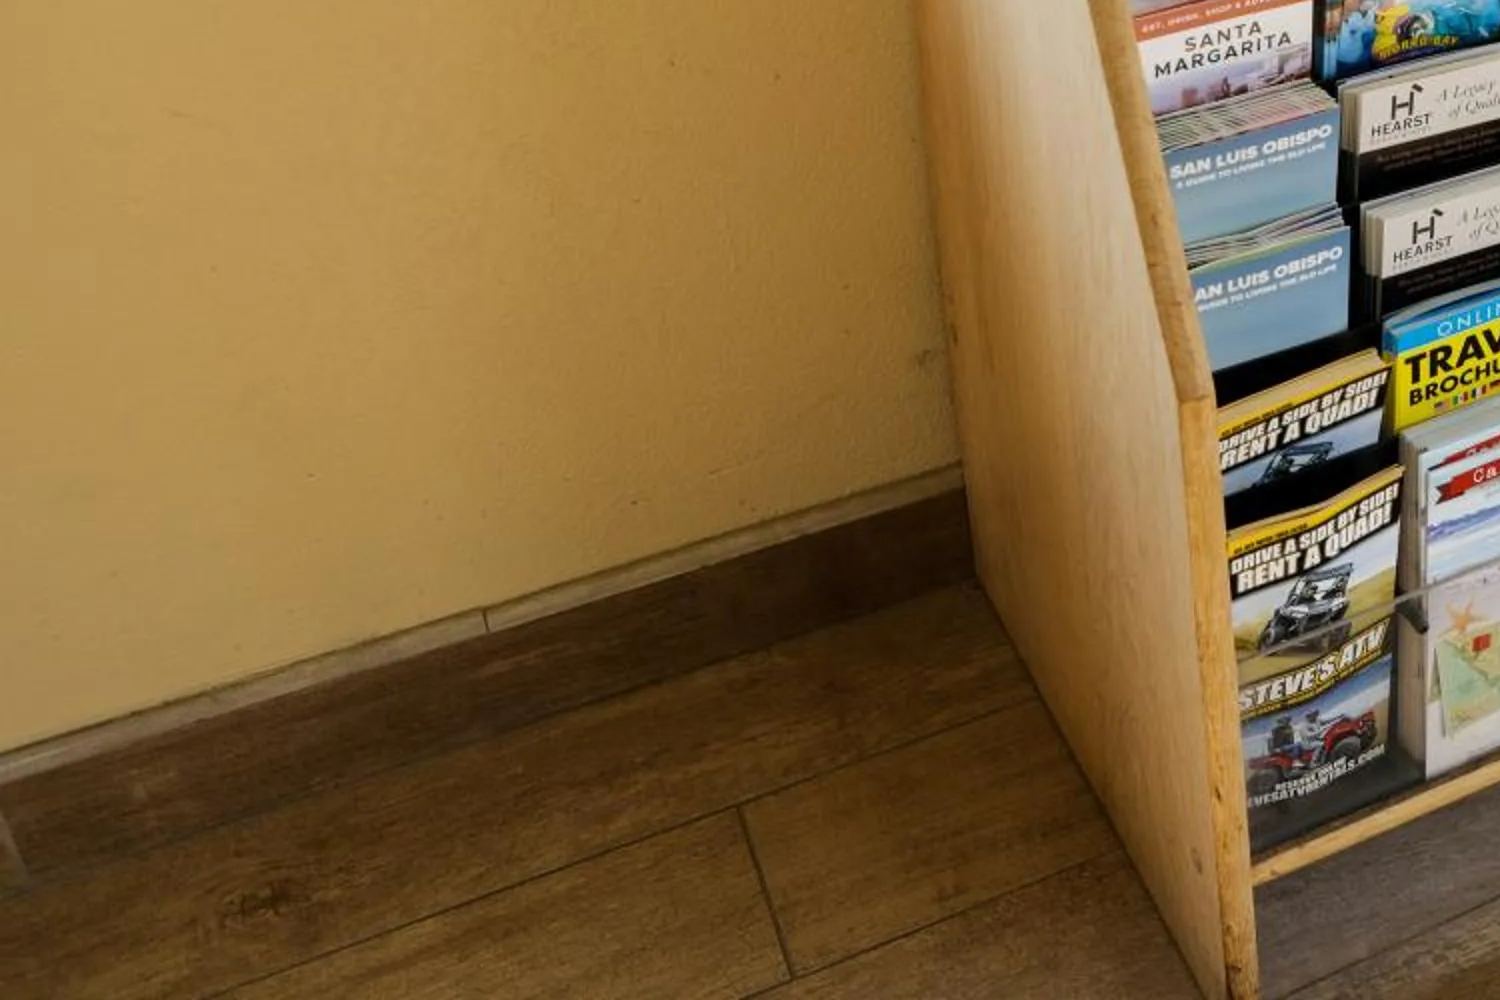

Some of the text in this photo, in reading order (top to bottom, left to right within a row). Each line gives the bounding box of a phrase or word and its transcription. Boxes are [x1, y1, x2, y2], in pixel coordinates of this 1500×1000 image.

[1154, 31, 1292, 78] MARGARITA
[1184, 20, 1263, 53] SANTA
[1169, 124, 1333, 180] SAN LUIS OBISPO
[1371, 113, 1434, 138] HEARST
[1393, 235, 1453, 263] HEARST
[1219, 371, 1389, 450] DRIVE A SIDE BY SIDE!
[1221, 389, 1378, 471] RENT A QUAD!
[1237, 507, 1392, 594] RENT A QUAD!
[1244, 651, 1337, 709] STEVE'S
